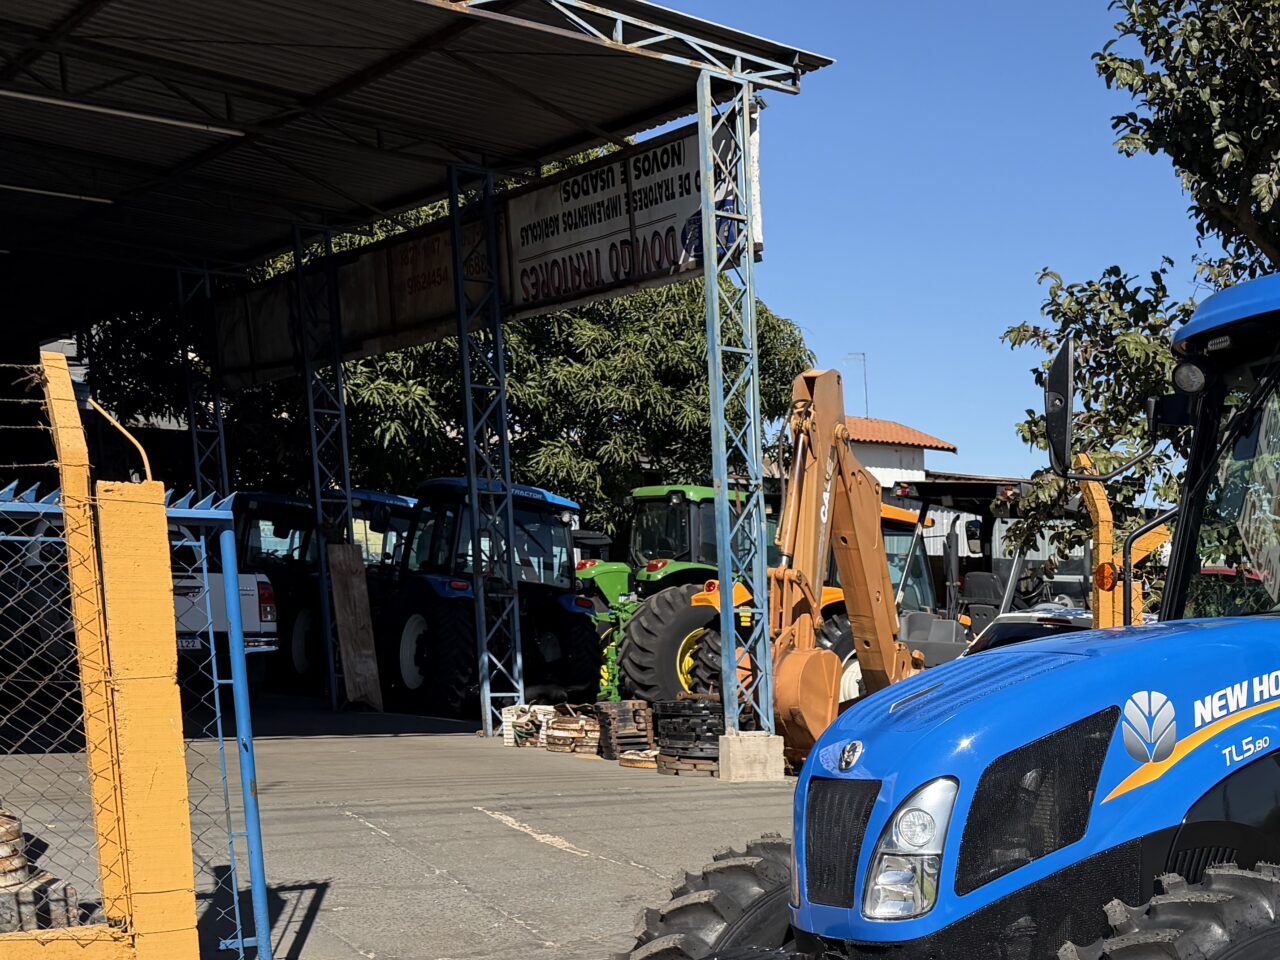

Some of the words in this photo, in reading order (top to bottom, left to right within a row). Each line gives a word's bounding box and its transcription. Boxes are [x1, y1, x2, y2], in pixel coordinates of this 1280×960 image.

[620, 161, 628, 185] E
[633, 139, 685, 180] (NOVOS
[559, 164, 616, 206] USADOS)
[633, 178, 676, 212] TRATORES
[679, 174, 691, 198] DE
[520, 215, 561, 248] AGRÍCOLAS
[562, 195, 623, 233] IMPLEMENTOS
[609, 225, 678, 281] DOVIGO
[520, 248, 606, 302] TRATORES
[511, 488, 543, 500] TRACTOR
[1193, 680, 1249, 728] NEW
[1221, 735, 1270, 767] TL5.80
